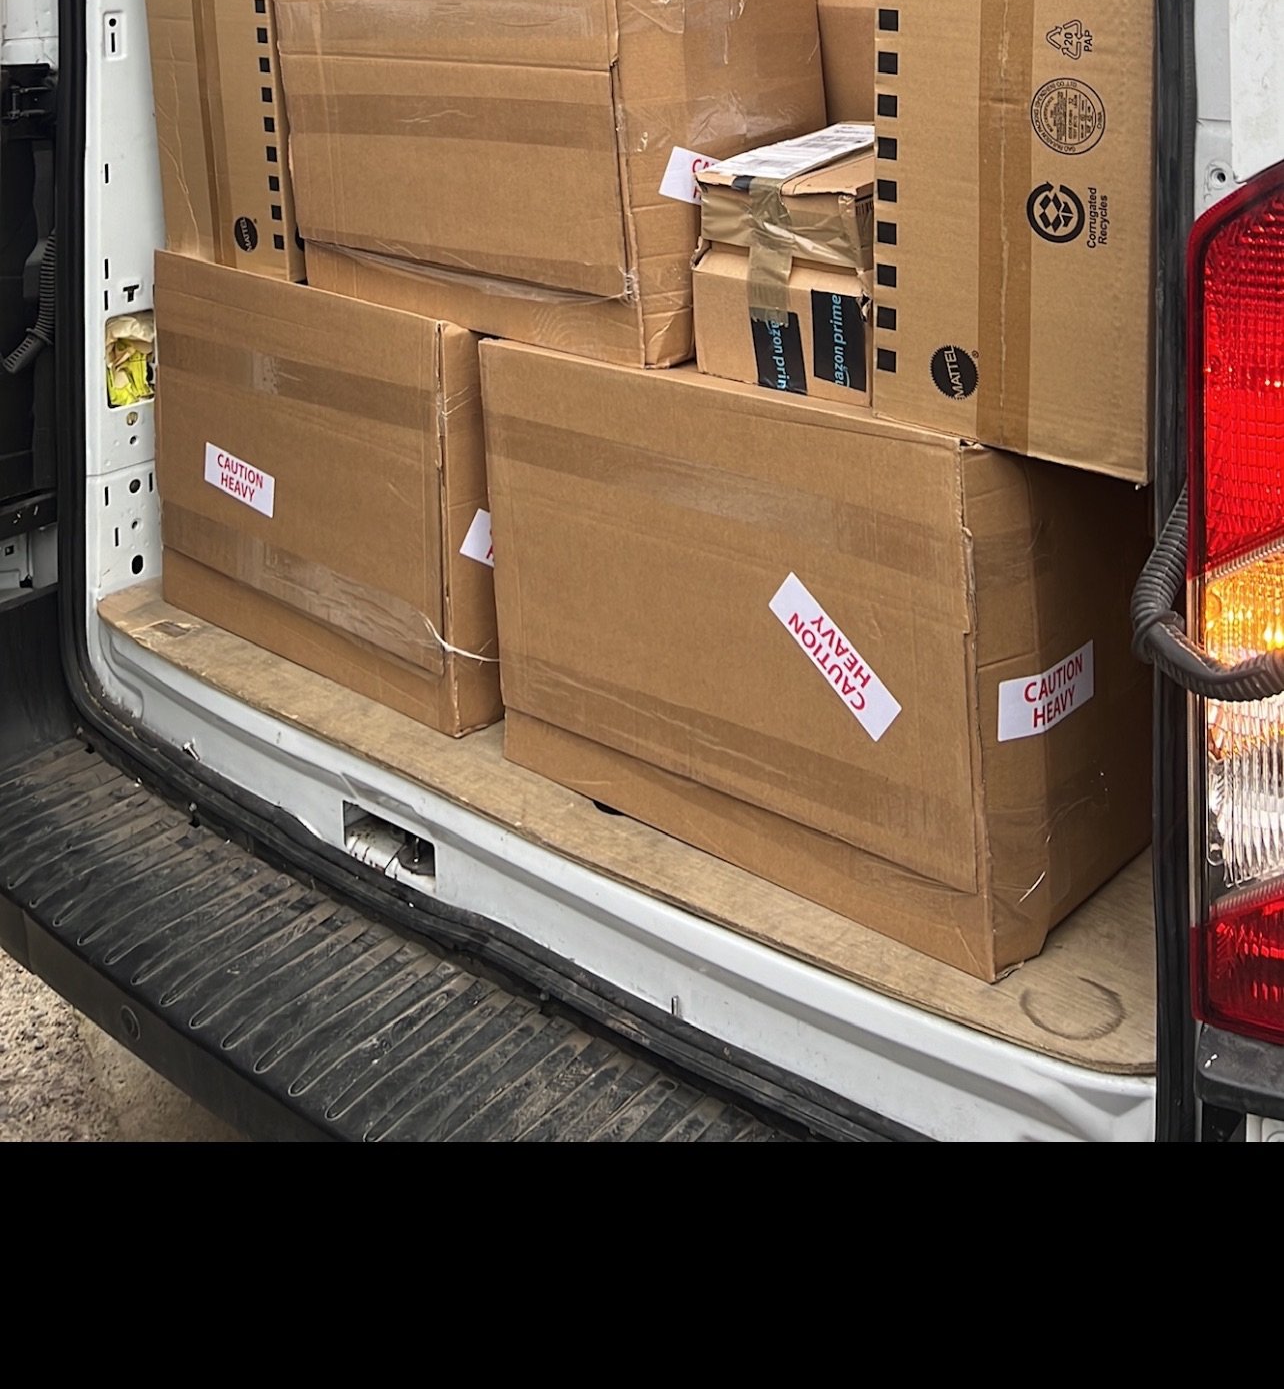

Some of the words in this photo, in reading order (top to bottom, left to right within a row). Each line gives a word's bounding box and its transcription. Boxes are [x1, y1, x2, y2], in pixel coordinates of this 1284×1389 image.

[1064, 32, 1073, 46] 20
[1084, 30, 1093, 52] PAP
[1086, 187, 1099, 248] Corrugated
[1098, 195, 1110, 245] Recycles
[830, 295, 846, 344] prime
[944, 345, 965, 399] MATTEL
[217, 454, 263, 489] CAUTION
[221, 472, 255, 502] HEAVY
[788, 612, 865, 710] CAUTION
[810, 615, 871, 688] HEAVY
[1024, 653, 1083, 703] CAUTION
[1033, 684, 1075, 728] HEAVY
